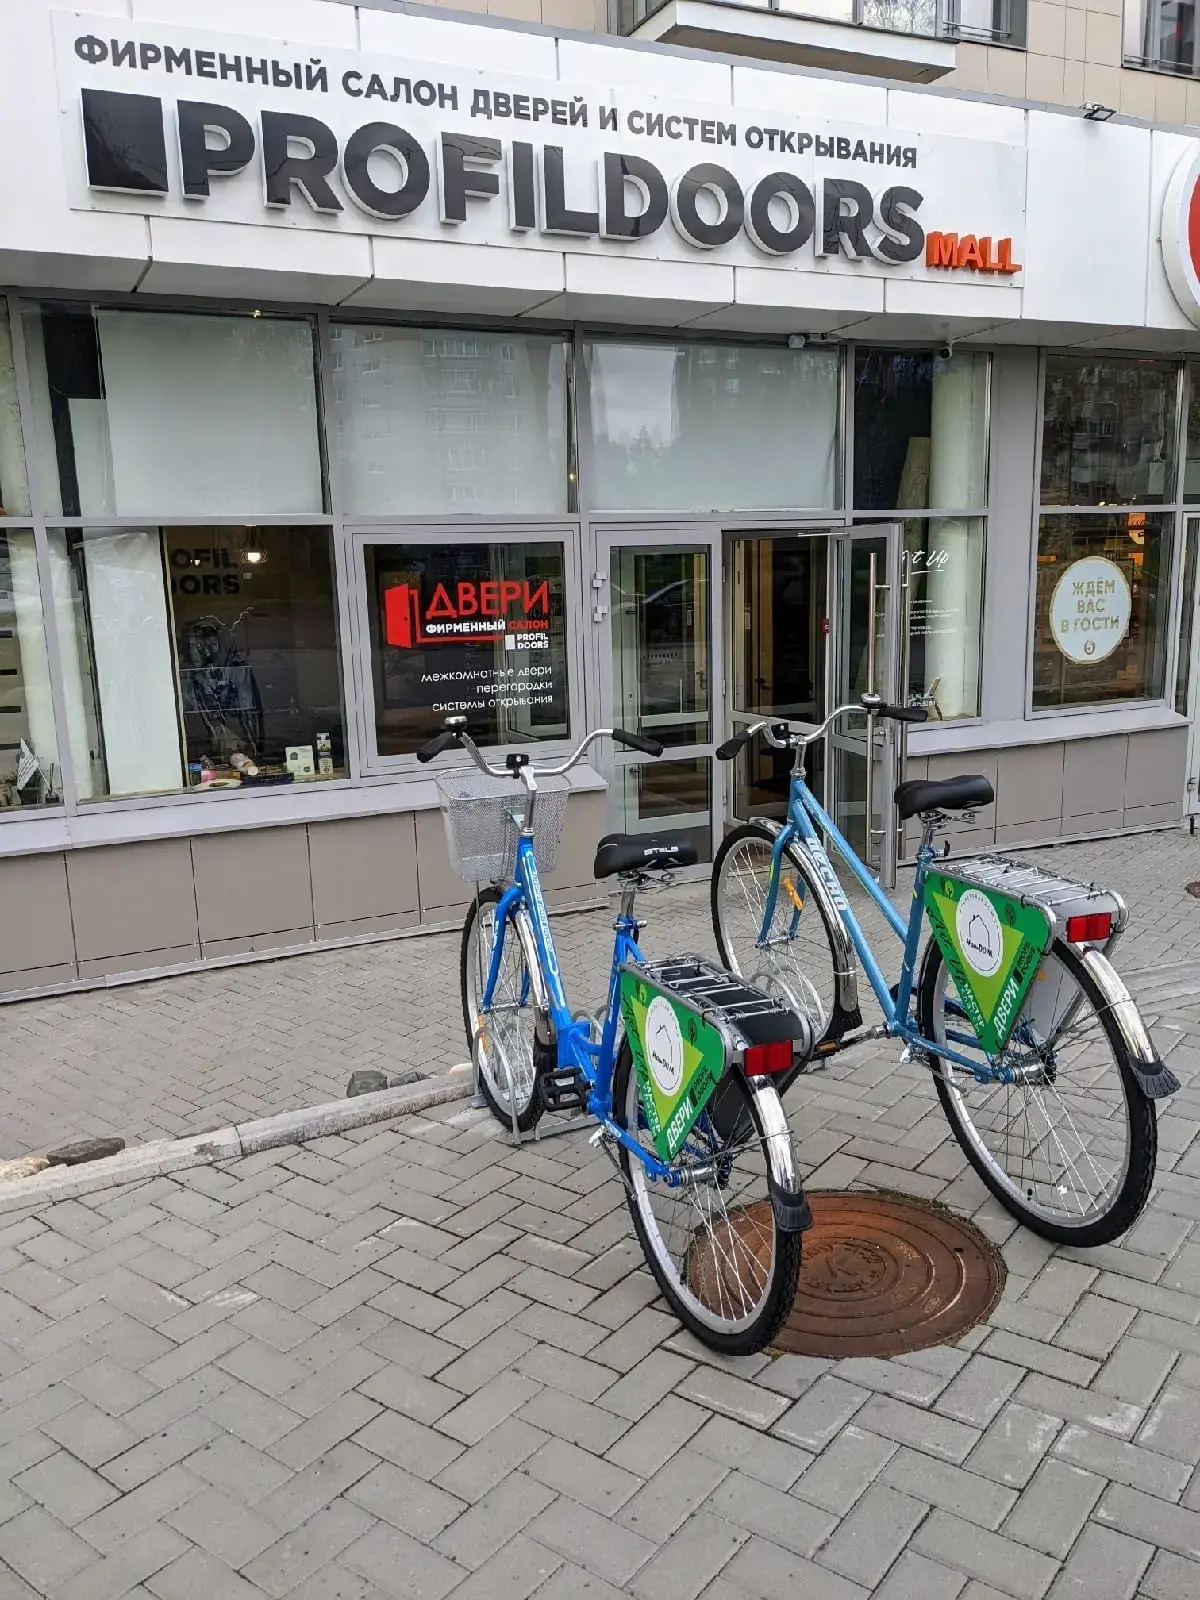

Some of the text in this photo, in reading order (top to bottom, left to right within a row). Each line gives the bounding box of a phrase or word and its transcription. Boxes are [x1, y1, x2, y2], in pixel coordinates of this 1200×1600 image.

[74, 34, 917, 169] ФИРМЕННЫЙ САЛОН ДВЕРЕЙ И СИСТЕМ ОТКРЫВАНИЯ
[177, 98, 926, 265] PROFILDOORS
[926, 231, 1022, 275] MALL
[171, 548, 238, 569] OFIL
[171, 574, 240, 595] ORS
[1072, 577, 1115, 597] ЖДЁМ
[426, 580, 549, 619] ДВЕРИ
[1077, 600, 1105, 614] ВАС
[426, 619, 506, 633] ФИРМЕННЫЙ
[1061, 616, 1119, 633] В ГОСТИ
[476, 681, 553, 695] перегородки
[432, 700, 485, 712] системы
[993, 976, 1019, 1039] ДВЕРИ
[665, 1095, 694, 1155] ДВЕРИ
